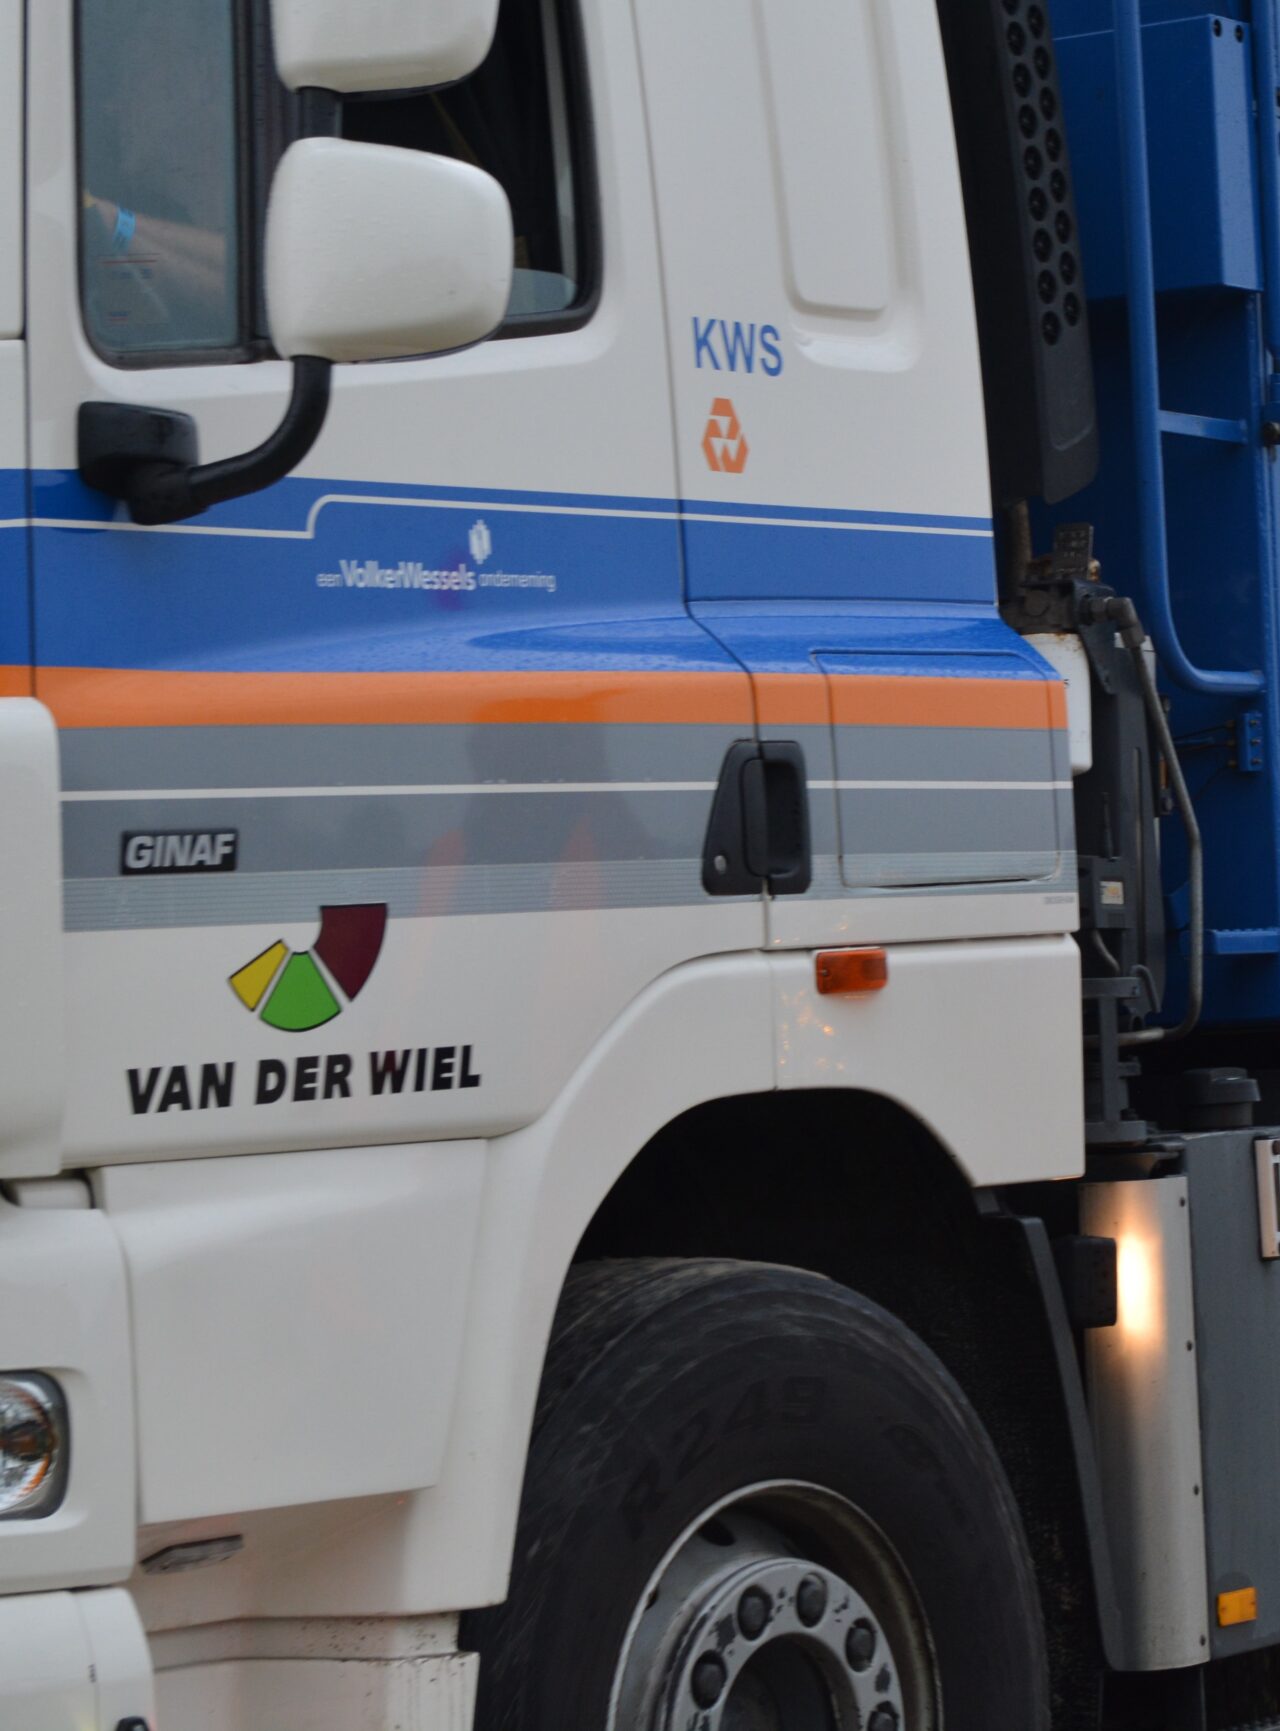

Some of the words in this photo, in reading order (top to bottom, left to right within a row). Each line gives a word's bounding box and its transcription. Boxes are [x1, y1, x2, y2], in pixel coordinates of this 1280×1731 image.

[692, 316, 784, 377] KWS
[316, 573, 341, 587] een
[339, 559, 476, 590] VolkerWessels
[478, 570, 557, 592] onderneming
[125, 833, 235, 869] GINAF
[126, 1061, 236, 1115] VAN
[254, 1053, 353, 1105] DER
[369, 1044, 481, 1096] WIEL
